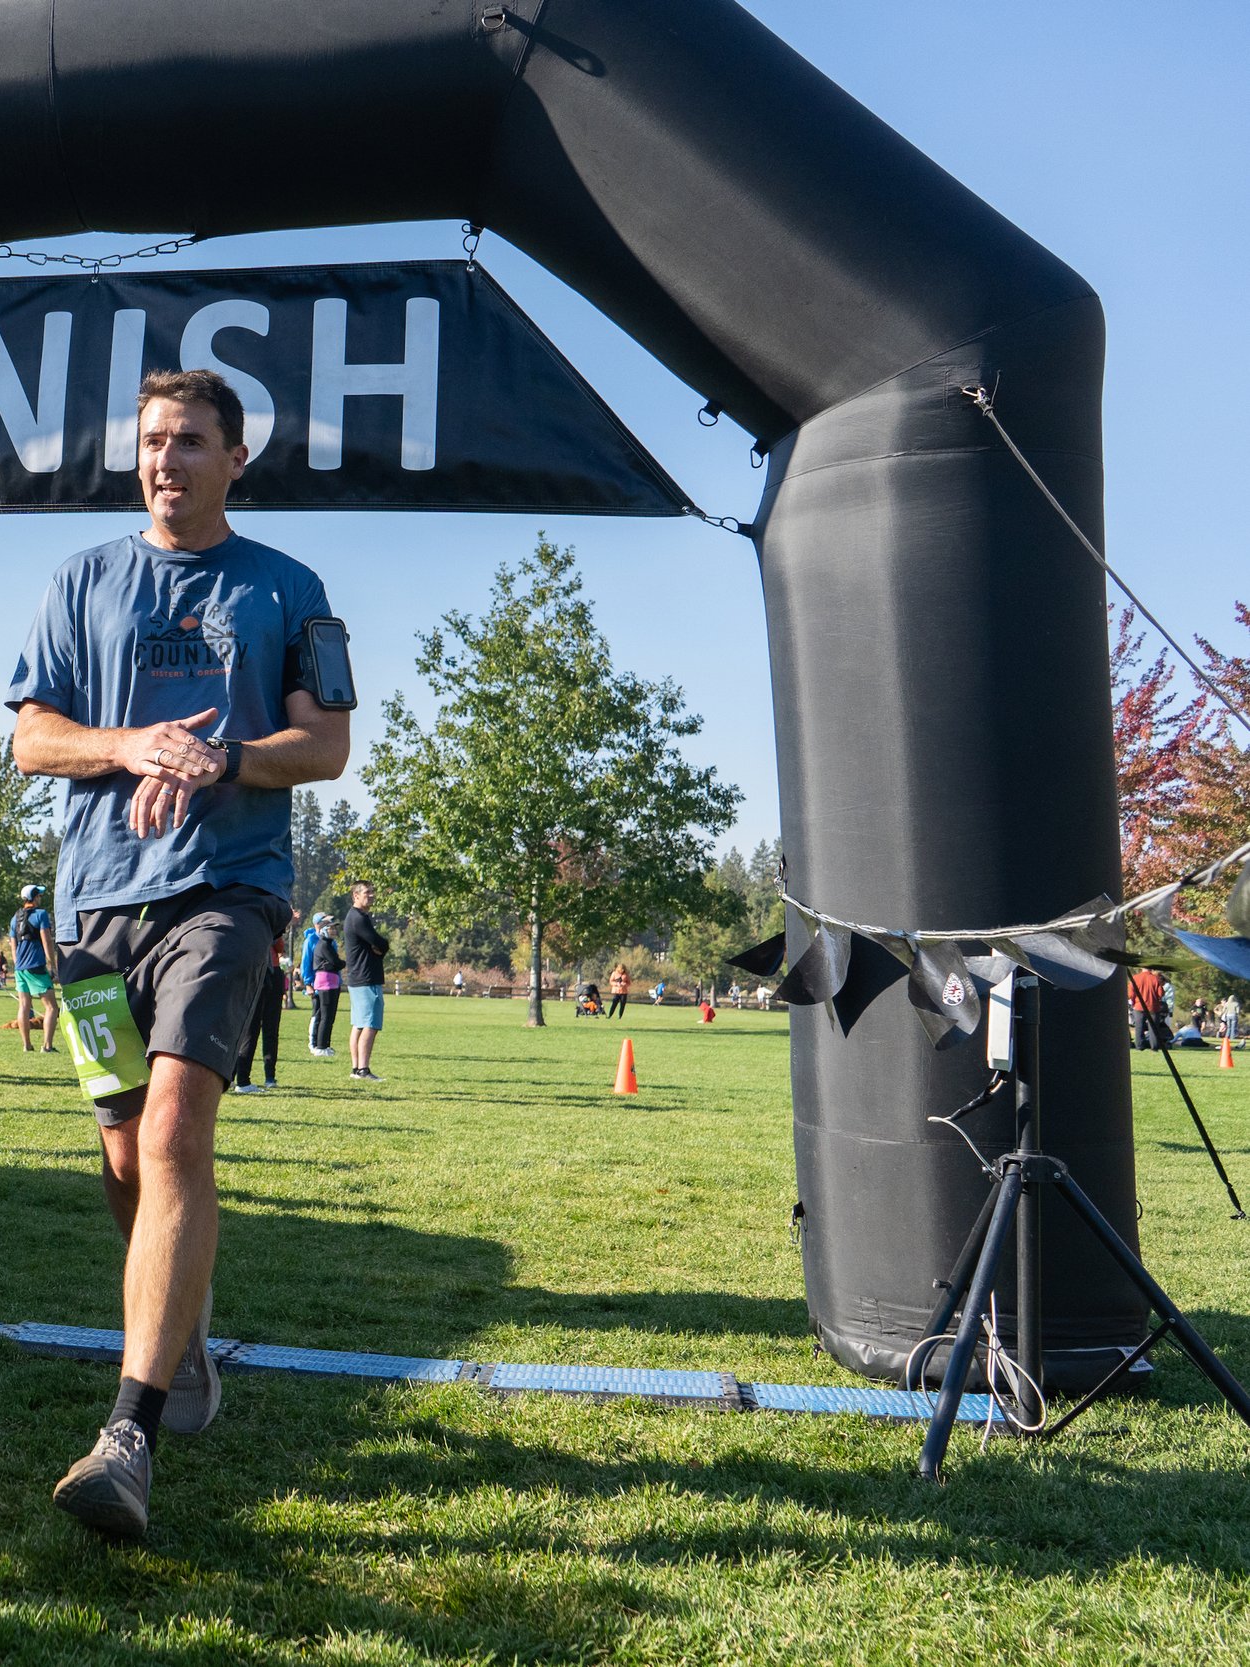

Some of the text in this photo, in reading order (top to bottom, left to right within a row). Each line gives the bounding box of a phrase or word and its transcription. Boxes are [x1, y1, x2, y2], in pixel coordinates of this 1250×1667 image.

[149, 600, 234, 629] SISTERS
[135, 641, 248, 671] COUNTRY
[151, 670, 184, 678] SISTERS
[65, 1013, 117, 1066] 105
